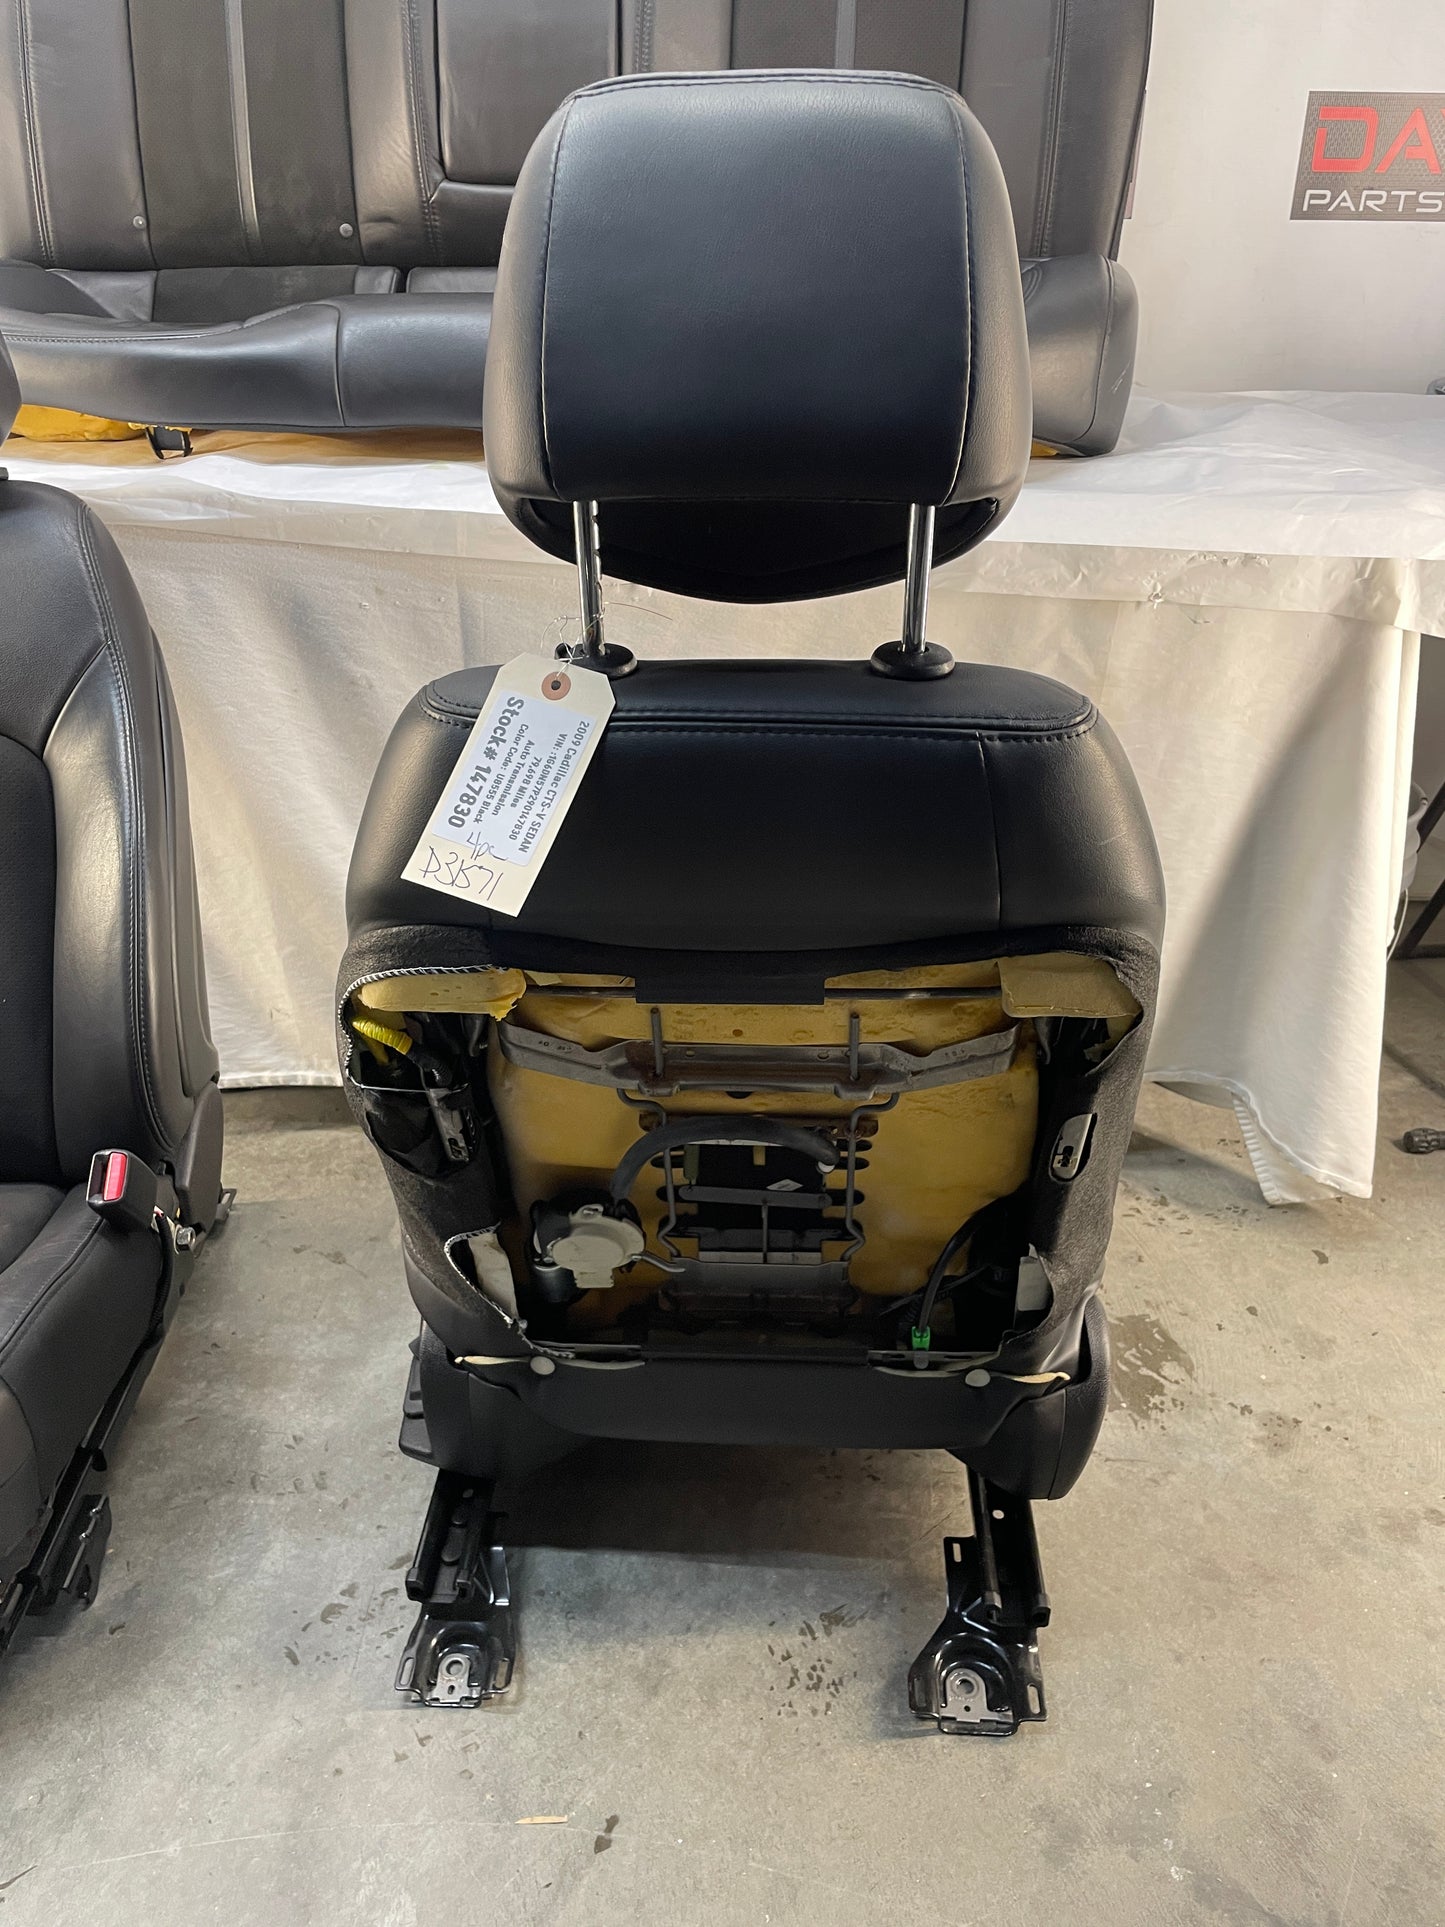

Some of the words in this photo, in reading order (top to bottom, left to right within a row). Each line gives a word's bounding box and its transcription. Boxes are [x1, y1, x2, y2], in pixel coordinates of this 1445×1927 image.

[1311, 106, 1445, 175] DA
[1302, 189, 1445, 213] PARTS
[483, 696, 524, 760] Stock#
[511, 722, 528, 746] Color
[552, 732, 566, 751] VIN:
[570, 720, 589, 746] 2009
[499, 745, 517, 771] Code:
[519, 739, 534, 761] Auto
[521, 755, 541, 785] 79,698
[550, 746, 576, 789] Cadillac
[447, 764, 492, 829] 147830
[485, 772, 504, 800] U8555
[491, 760, 524, 816] Transmission
[509, 785, 527, 809] Miles
[472, 800, 490, 824] Black
[534, 788, 556, 819] CTS-V
[518, 819, 540, 853] SEDAN
